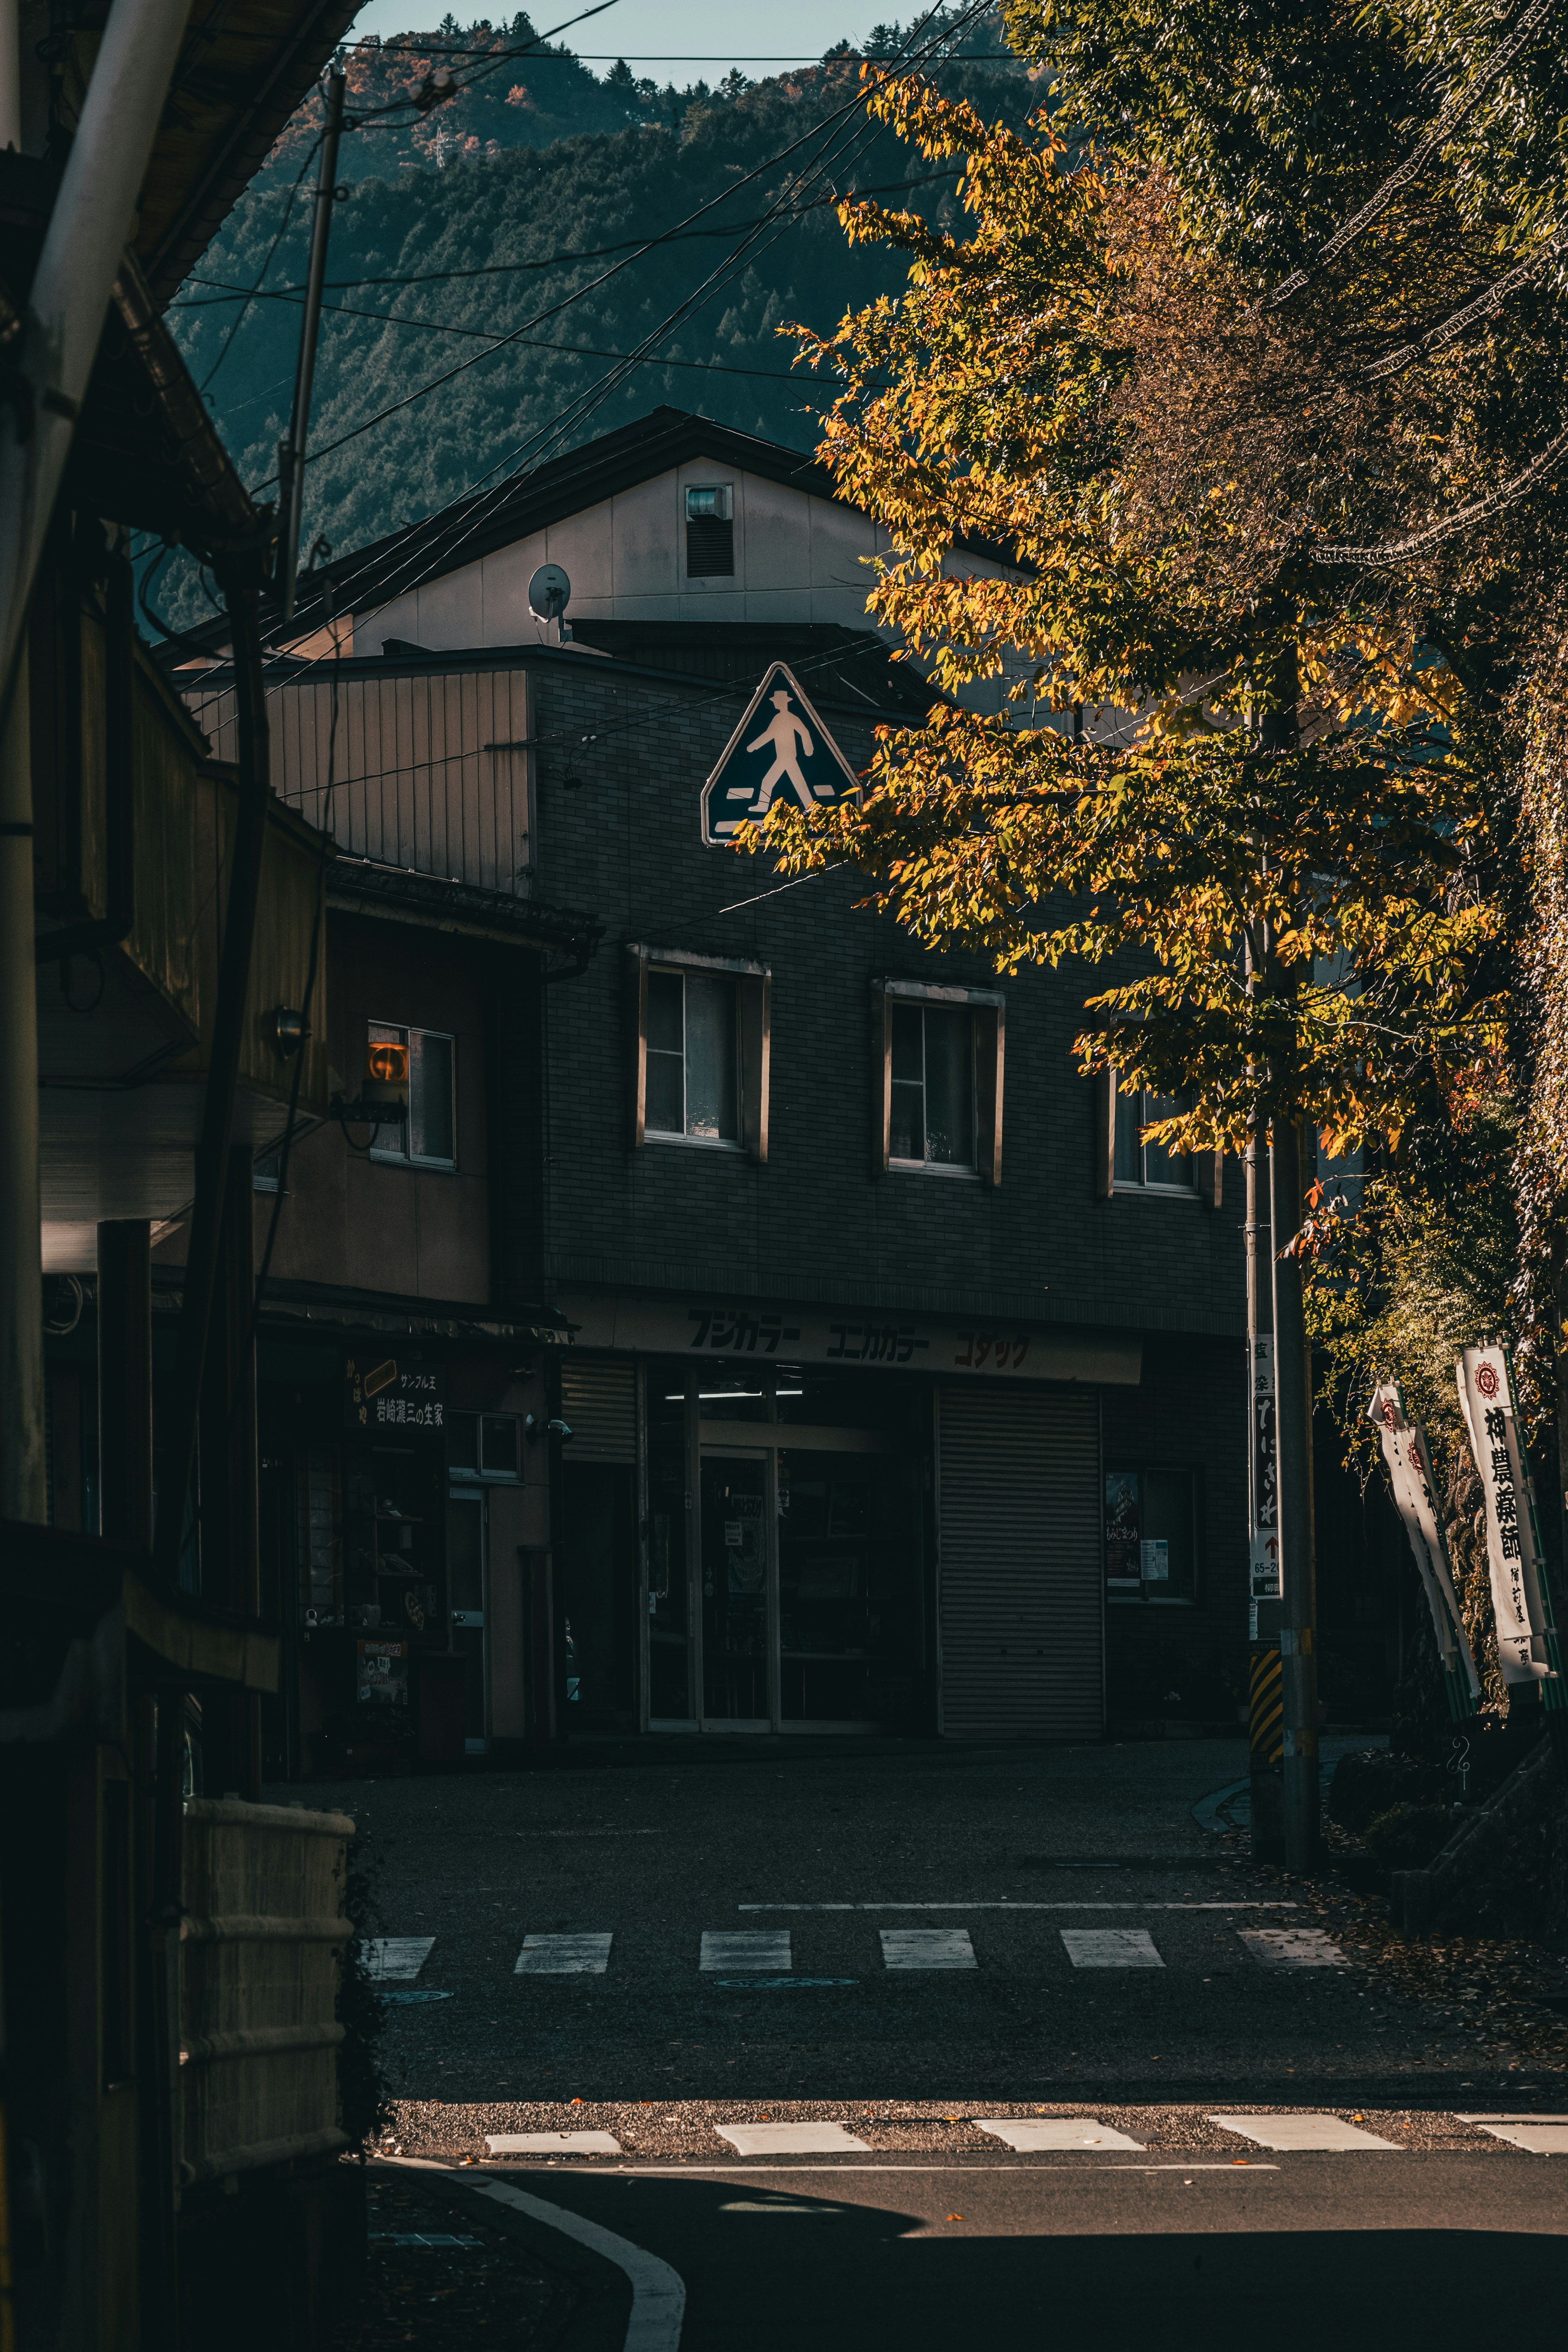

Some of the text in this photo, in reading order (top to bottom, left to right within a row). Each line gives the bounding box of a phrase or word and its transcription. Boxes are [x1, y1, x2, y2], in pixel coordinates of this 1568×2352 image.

[688, 1309, 1031, 1369] フジカラー コニカカラー コダック
[1255, 1342, 1268, 1391] 藍染
[401, 1374, 436, 1390] サンプル王
[377, 1398, 443, 1426] 岩崎瀧三の生家
[1106, 1526, 1138, 1541] もみじまつり
